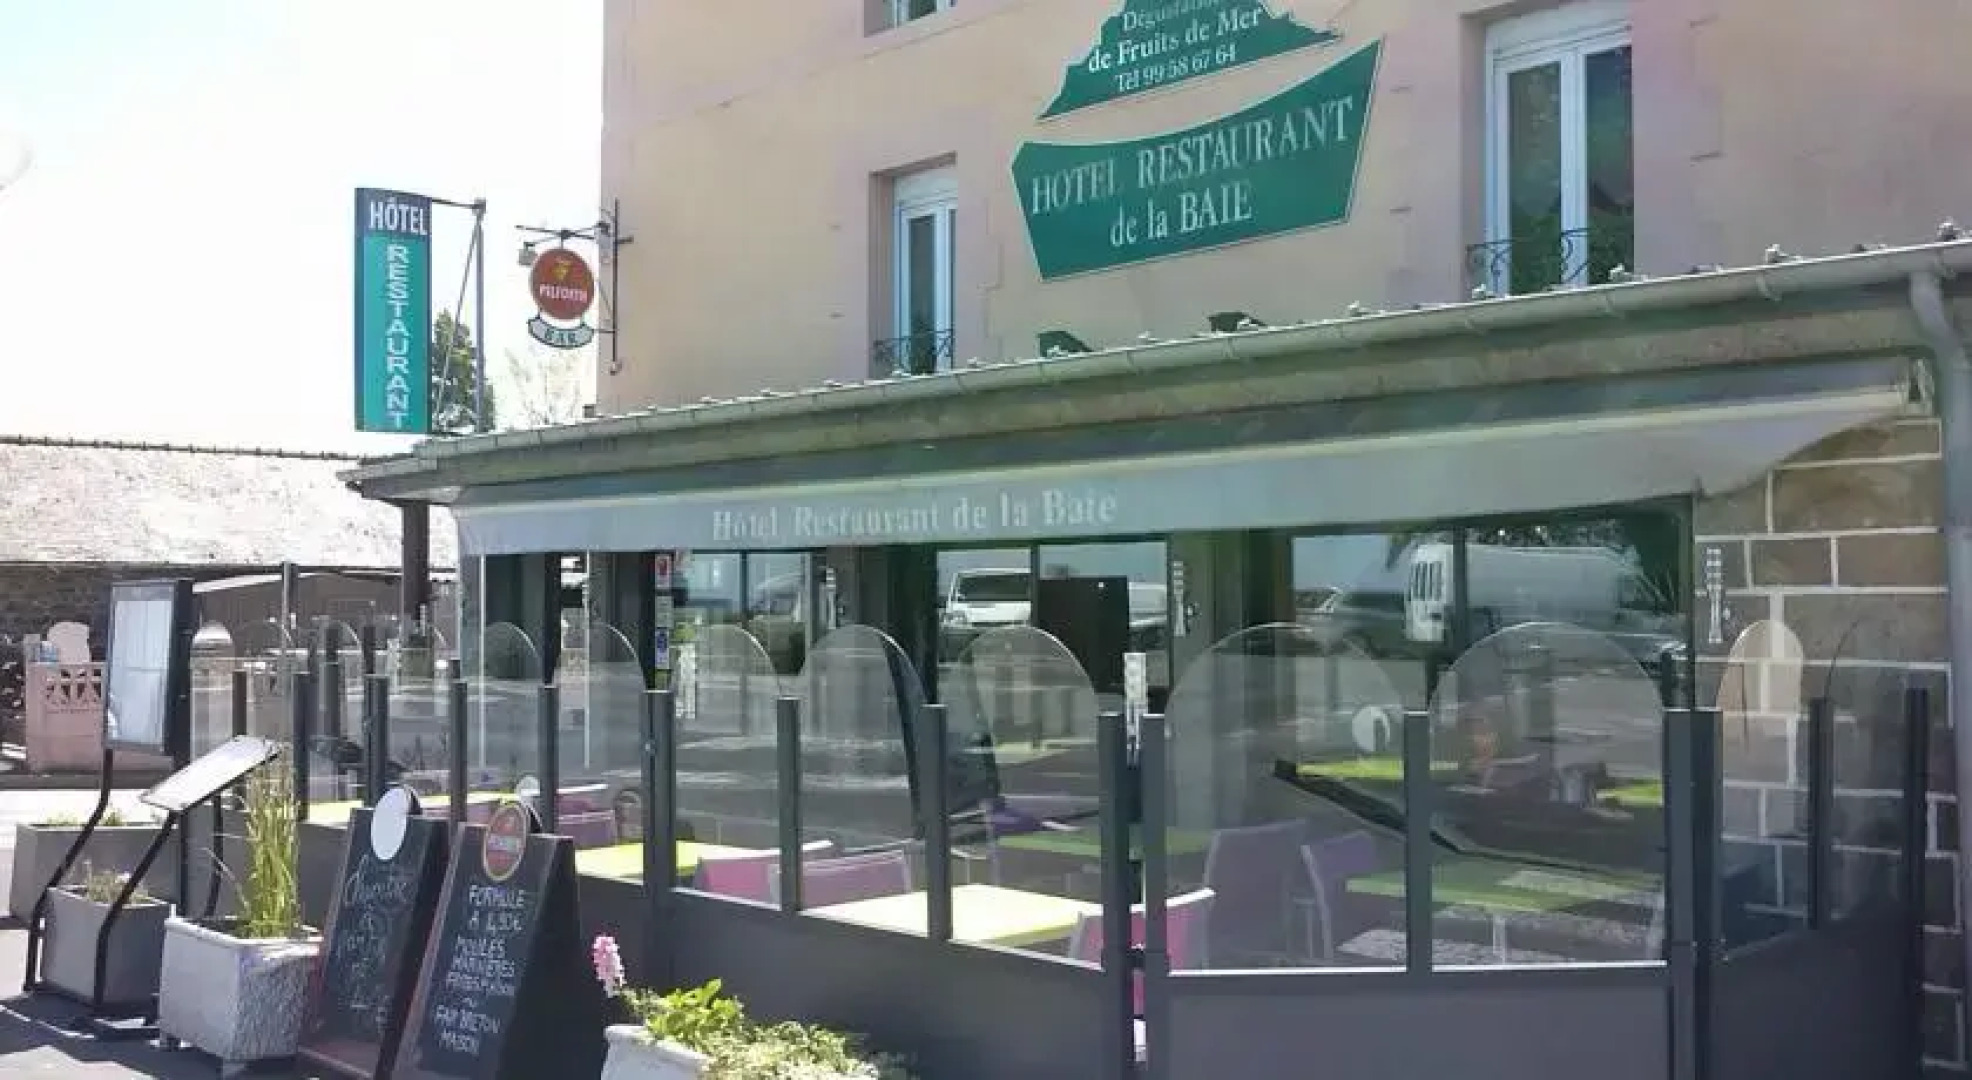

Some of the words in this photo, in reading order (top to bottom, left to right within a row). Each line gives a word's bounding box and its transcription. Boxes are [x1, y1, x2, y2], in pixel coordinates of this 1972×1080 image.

[1087, 48, 1112, 74] de
[1117, 32, 1180, 65] Fruits
[1184, 18, 1211, 46] de
[1215, 6, 1263, 37] Mer
[1142, 64, 1165, 86] 99
[1168, 55, 1189, 79] 58
[1192, 48, 1211, 74] 67
[1215, 42, 1237, 65] 64
[1031, 158, 1119, 215] HOTEL
[1137, 97, 1353, 189] RESTAURANT
[369, 196, 429, 236] HÔTEL
[1110, 206, 1138, 248] de
[1147, 199, 1169, 240] la
[1179, 182, 1252, 234] BAIE
[384, 244, 411, 429] RESTAURANT
[794, 500, 940, 538] Restaurant
[952, 496, 987, 530] de
[1001, 492, 1029, 528] la
[1041, 488, 1119, 527] Baie
